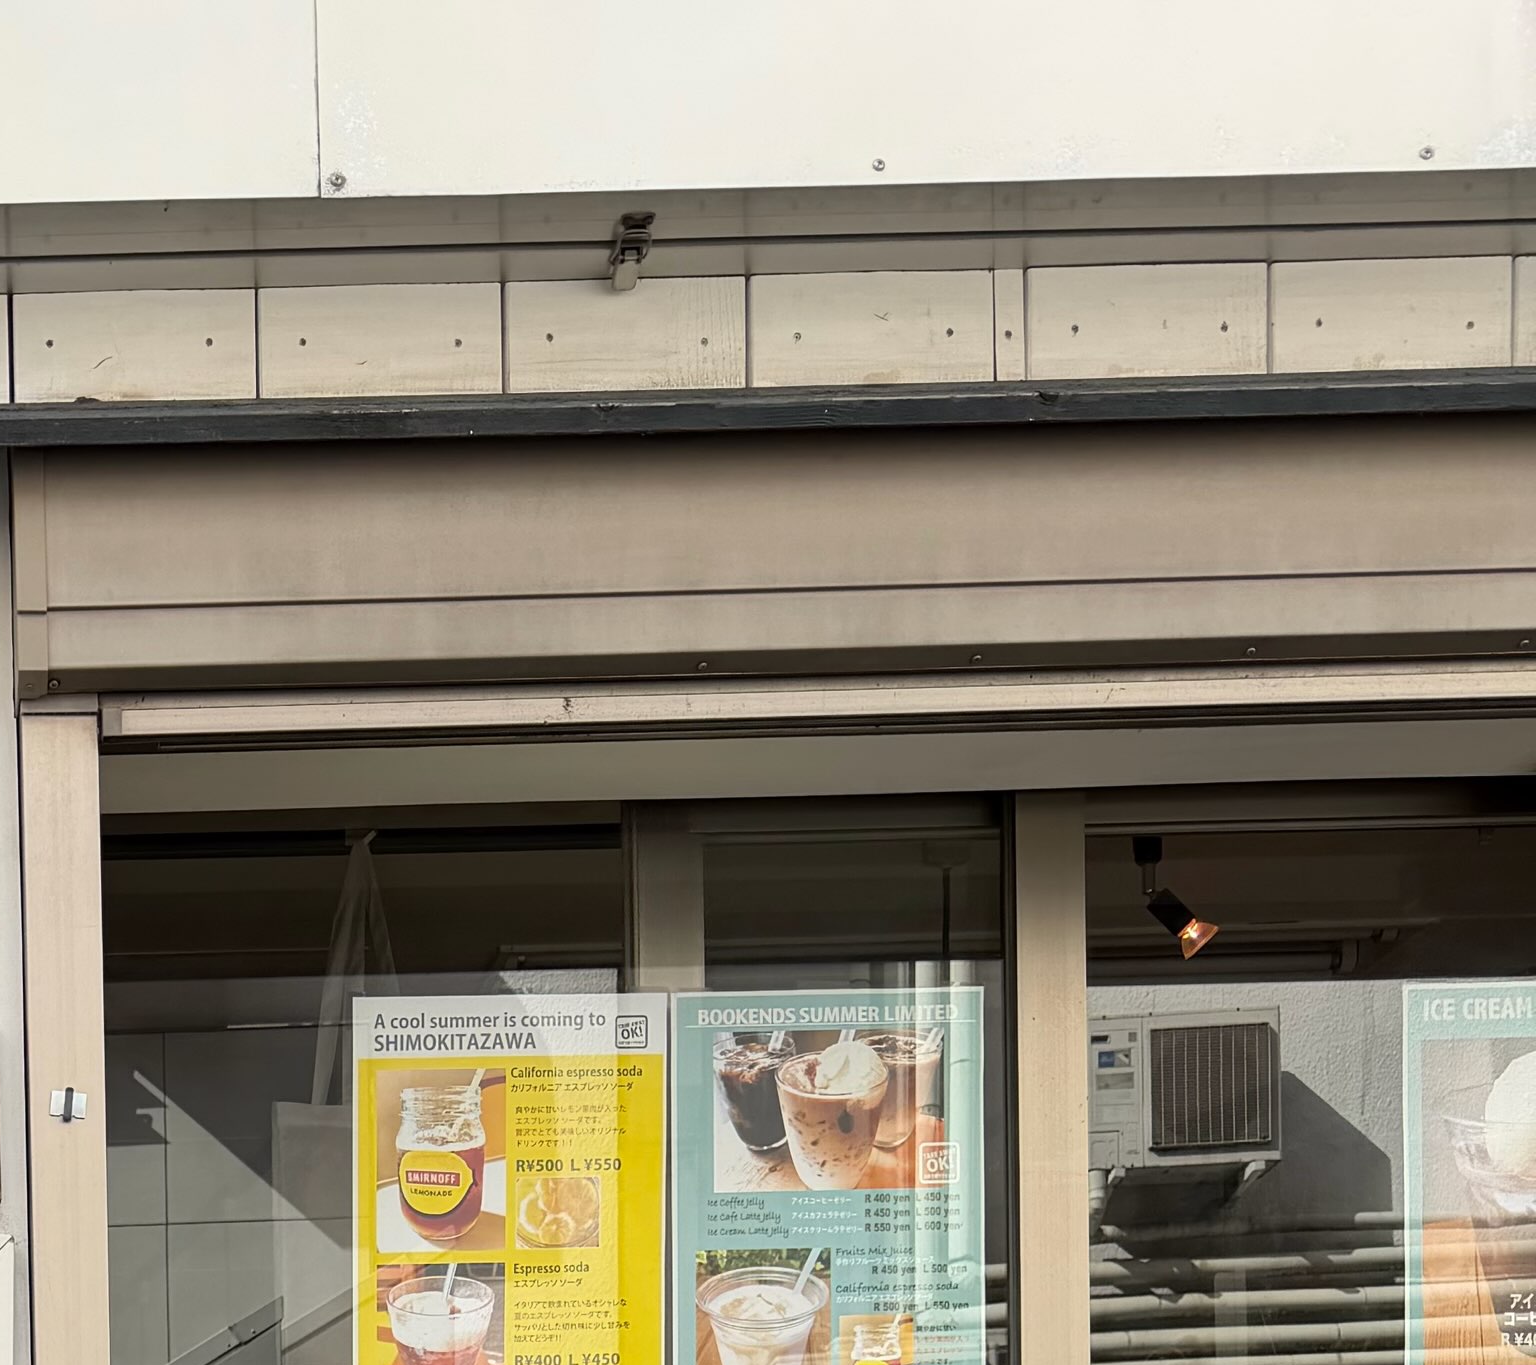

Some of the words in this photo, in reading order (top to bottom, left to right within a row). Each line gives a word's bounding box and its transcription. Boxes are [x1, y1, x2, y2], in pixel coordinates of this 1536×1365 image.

[697, 1007, 796, 1025] BOOKENDS
[798, 1006, 880, 1024] SUMMER
[883, 1003, 958, 1022] LIMITED
[1422, 998, 1455, 1022] ICE
[1462, 997, 1533, 1020] CREAM
[374, 1013, 386, 1030] A
[389, 1013, 425, 1029] cool
[430, 1013, 498, 1029] summer
[503, 1012, 517, 1028] is
[521, 1014, 584, 1030] coming
[589, 1011, 606, 1026] to
[620, 1023, 644, 1040] OK!
[374, 1032, 537, 1052] SHIMOKITAZAWA
[510, 1066, 564, 1079] California
[566, 1067, 614, 1079] espresso
[617, 1065, 643, 1077] soda
[570, 1158, 581, 1172] L
[584, 1157, 622, 1172] ¥550
[407, 1171, 457, 1185] SMIRNOFF
[410, 1188, 453, 1197] LEMONADE
[513, 1262, 561, 1276] Espresso
[563, 1261, 589, 1273] soda
[581, 1352, 620, 1365] ¥450
